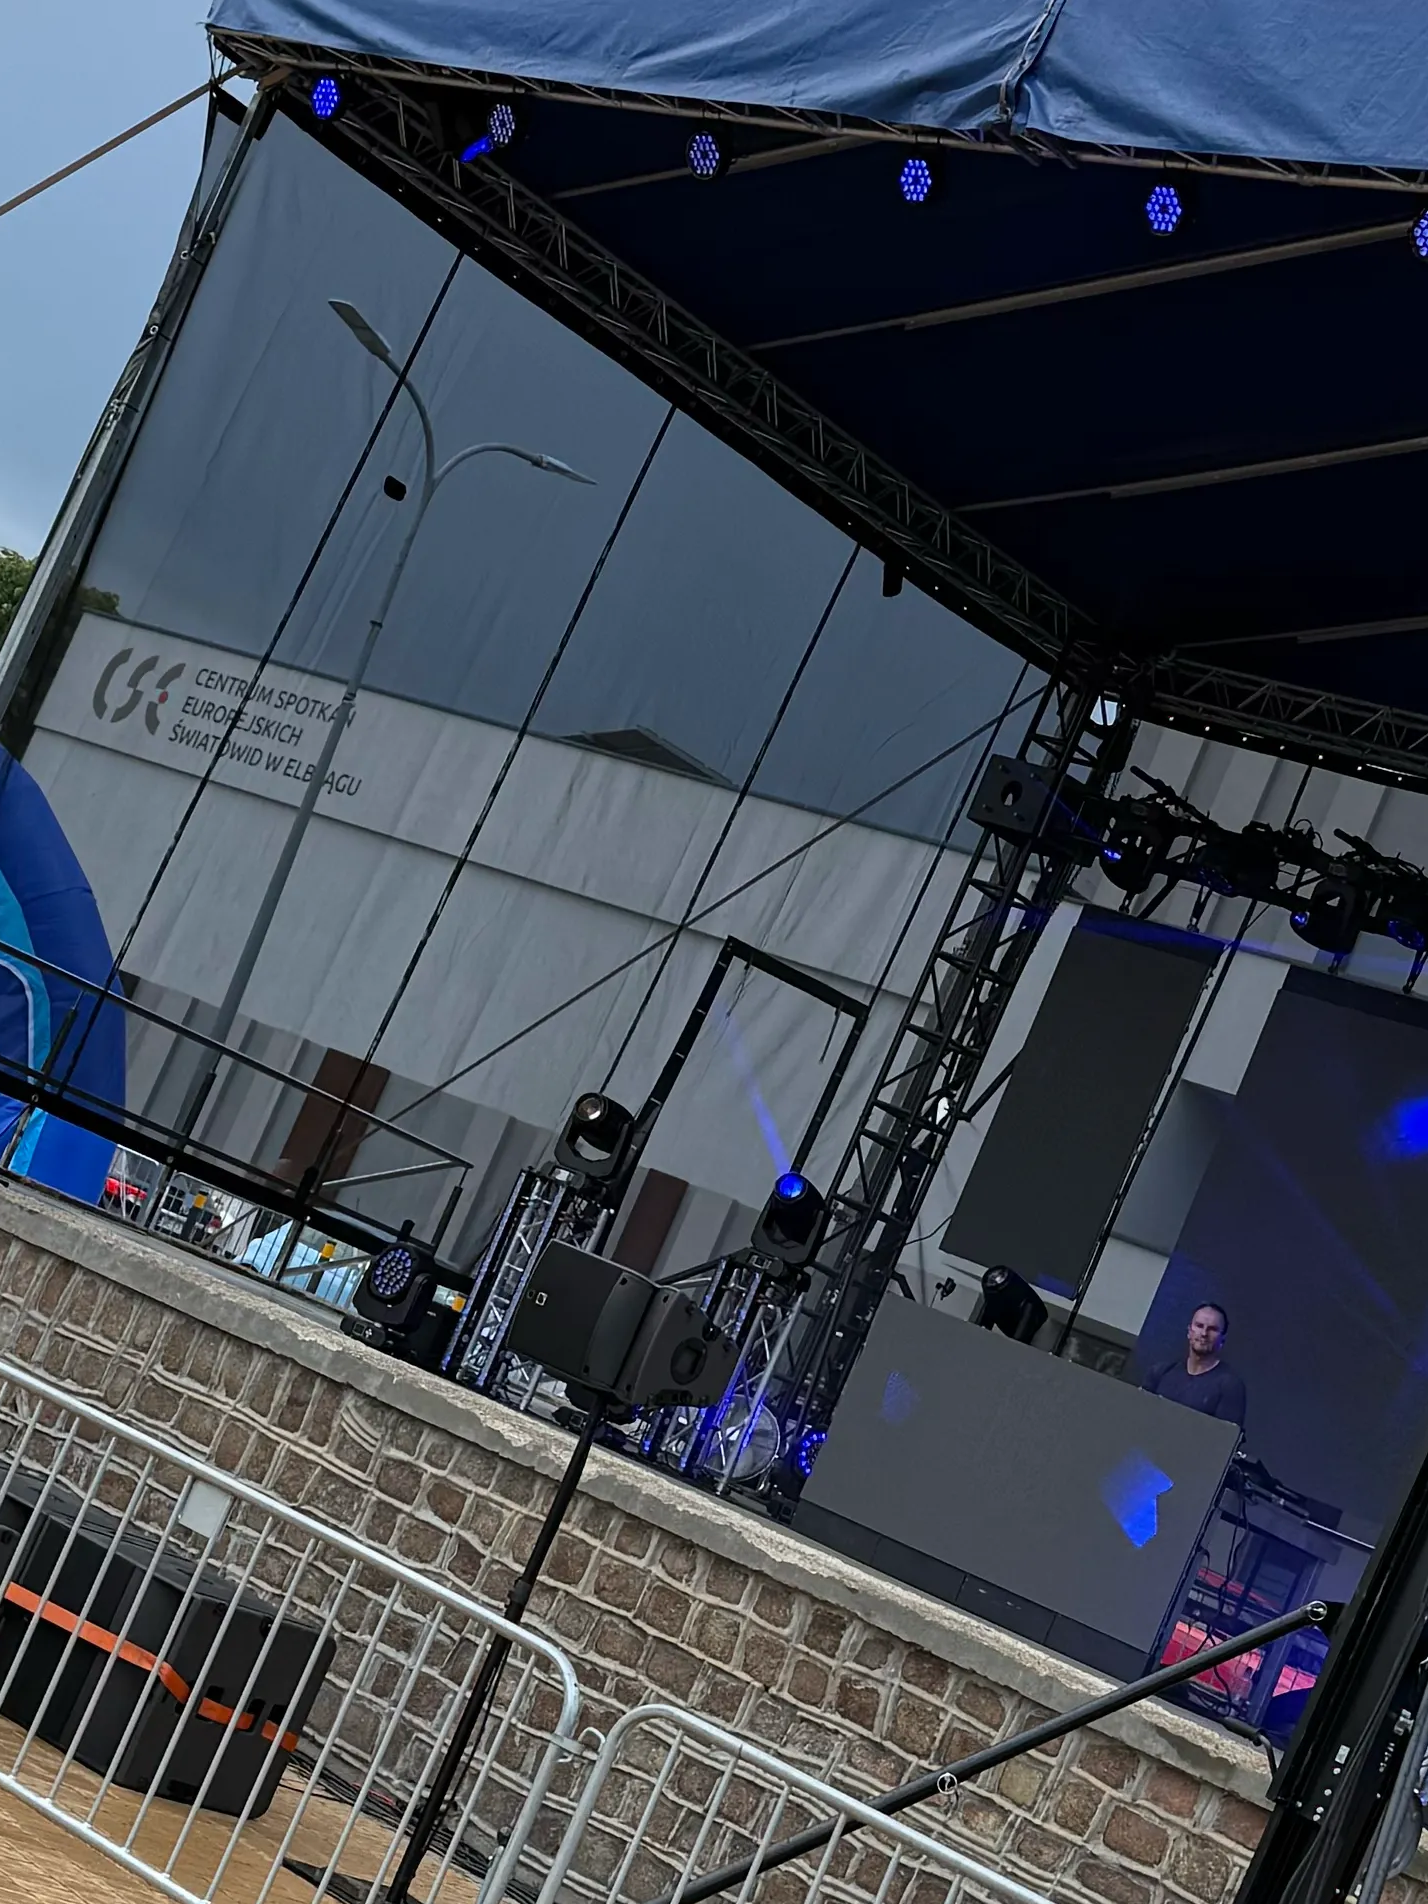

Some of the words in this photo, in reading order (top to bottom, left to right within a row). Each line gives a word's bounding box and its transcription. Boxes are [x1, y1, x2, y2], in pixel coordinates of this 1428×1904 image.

[195, 668, 275, 706] CENTRUM
[181, 695, 304, 747] EUROPEJSKICH
[168, 718, 263, 767] ŚWIATOWID
[265, 752, 284, 773] W
[282, 757, 362, 796] ELBĄGU
